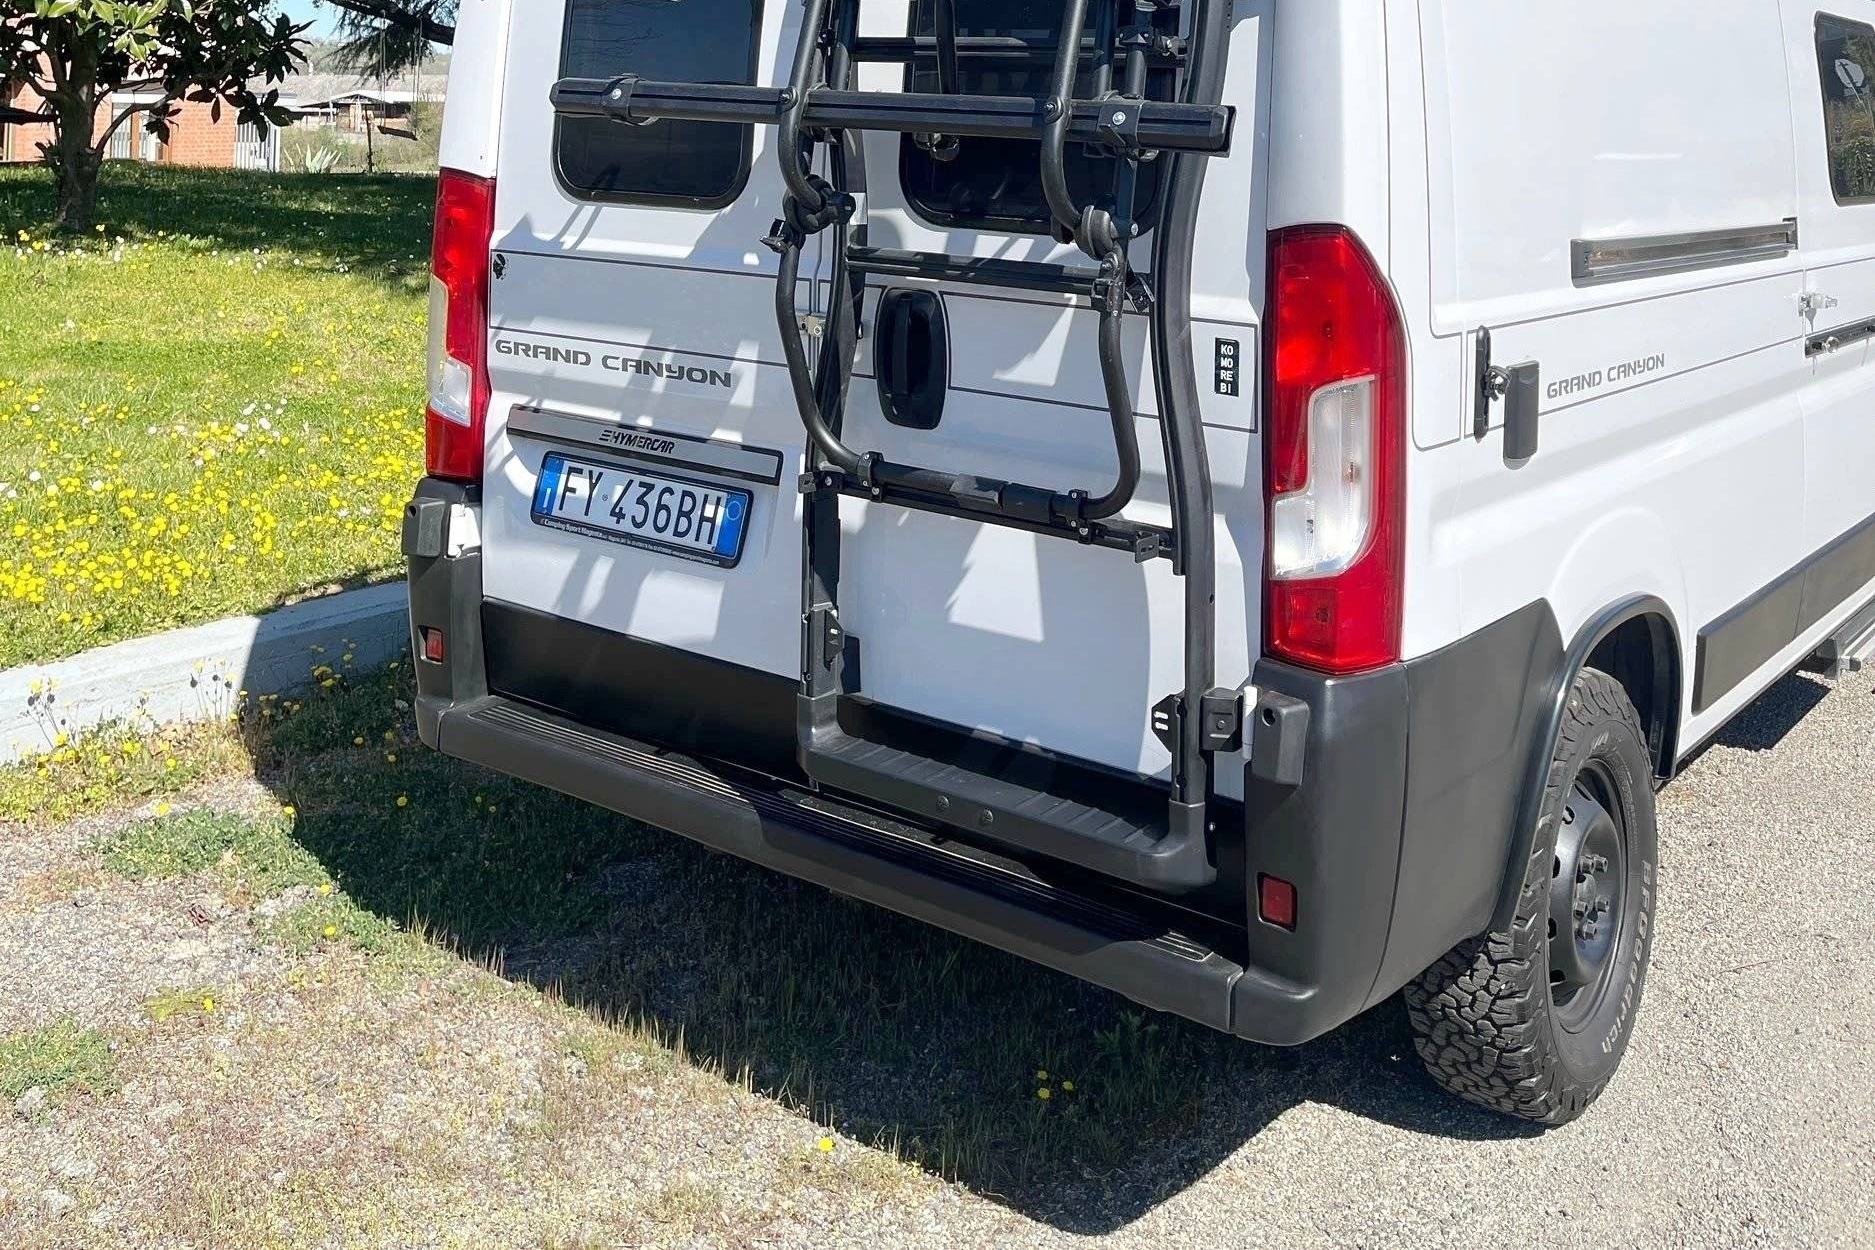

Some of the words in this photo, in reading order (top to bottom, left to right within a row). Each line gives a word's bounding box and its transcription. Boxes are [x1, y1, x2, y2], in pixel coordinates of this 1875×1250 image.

[495, 339, 592, 367] GRAND
[601, 354, 732, 388] CANYON
[1546, 369, 1603, 400] GRAND
[1606, 352, 1665, 383] CANYON
[558, 466, 604, 517] FY
[609, 478, 722, 545] 436BH
